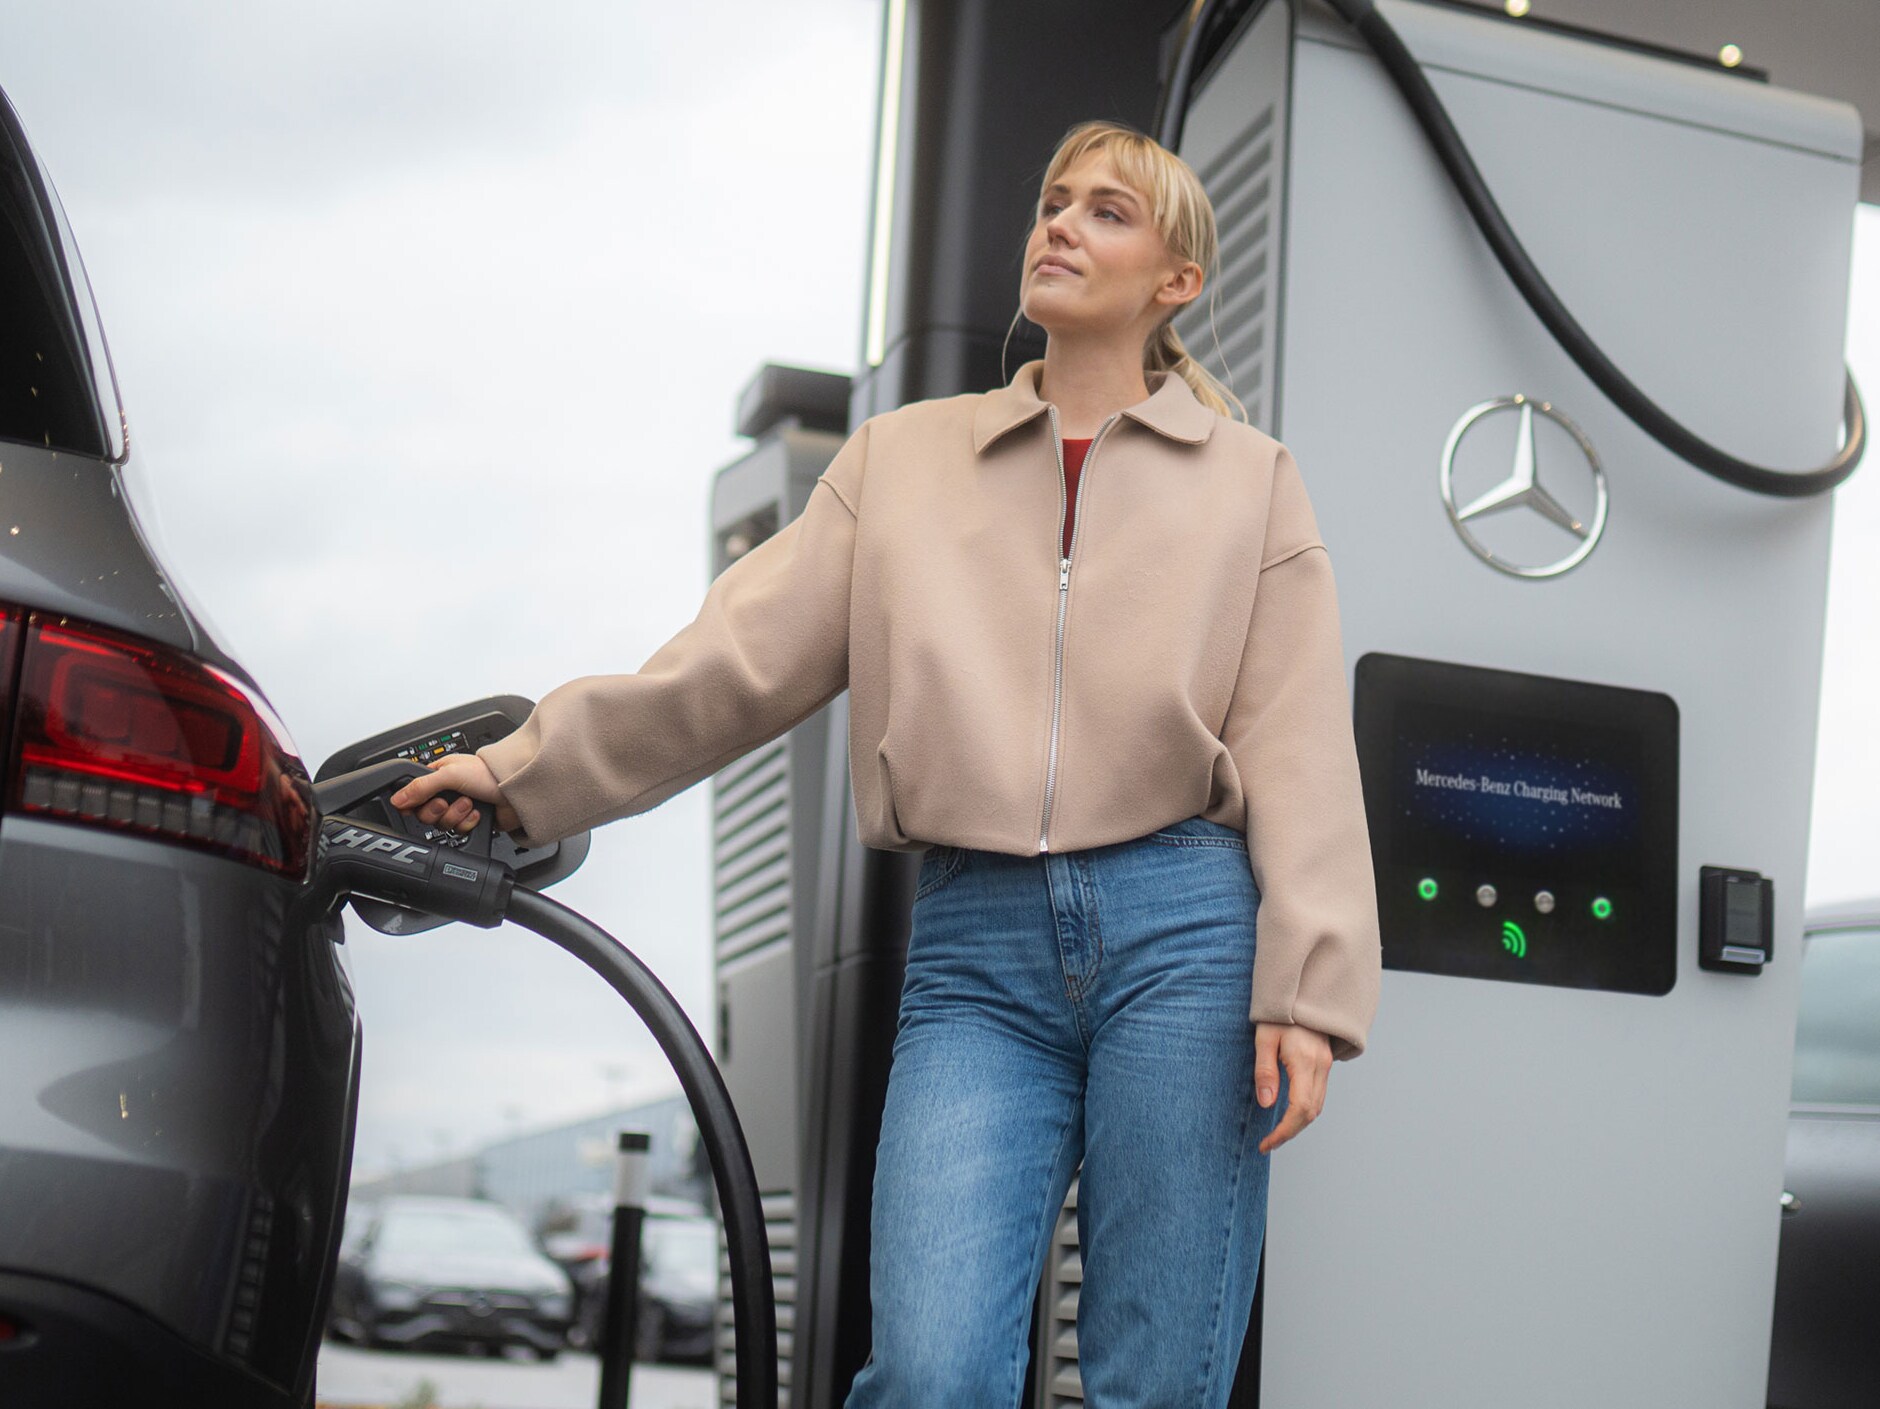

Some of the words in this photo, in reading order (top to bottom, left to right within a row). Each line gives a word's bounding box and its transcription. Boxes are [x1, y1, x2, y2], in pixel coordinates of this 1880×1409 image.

[1513, 780, 1568, 805] Charging
[1571, 787, 1622, 809] Network
[331, 829, 429, 864] HPC
